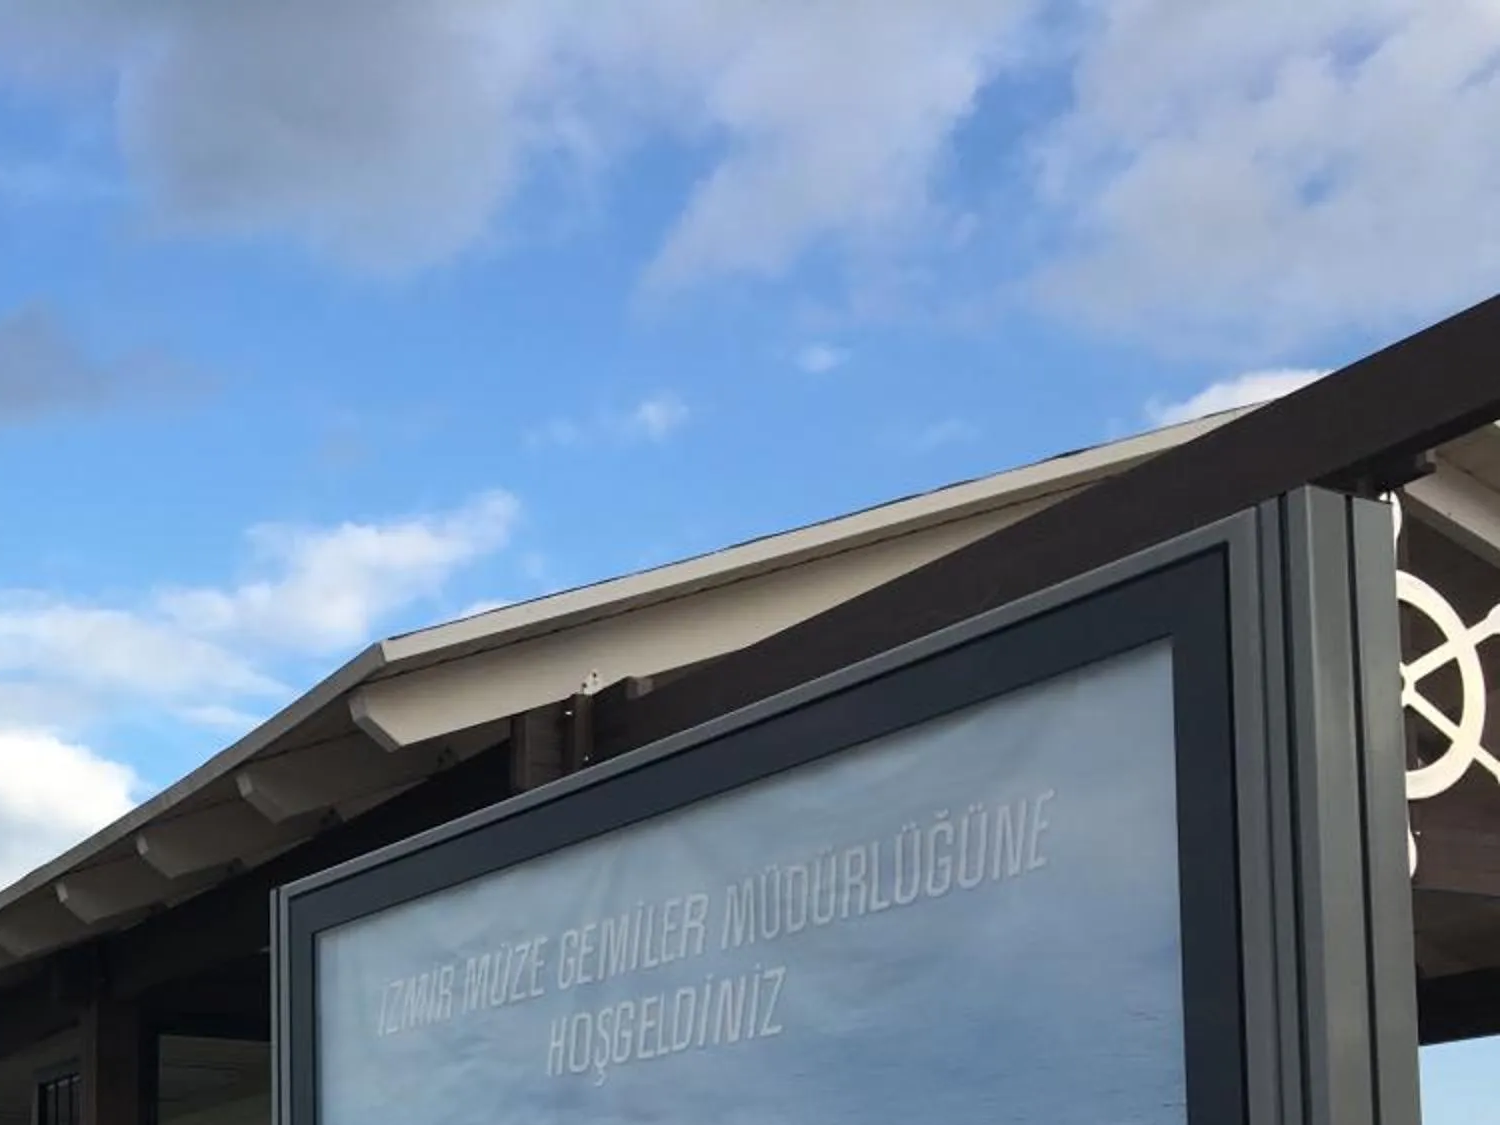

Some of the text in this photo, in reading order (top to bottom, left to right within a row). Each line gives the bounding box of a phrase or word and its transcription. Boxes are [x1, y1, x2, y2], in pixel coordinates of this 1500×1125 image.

[377, 788, 1055, 1038] İZMİR MÜZE GEMİLER MÜDÜRLÜĞÜNE
[547, 966, 787, 1087] HOŞGELDİNİZ
